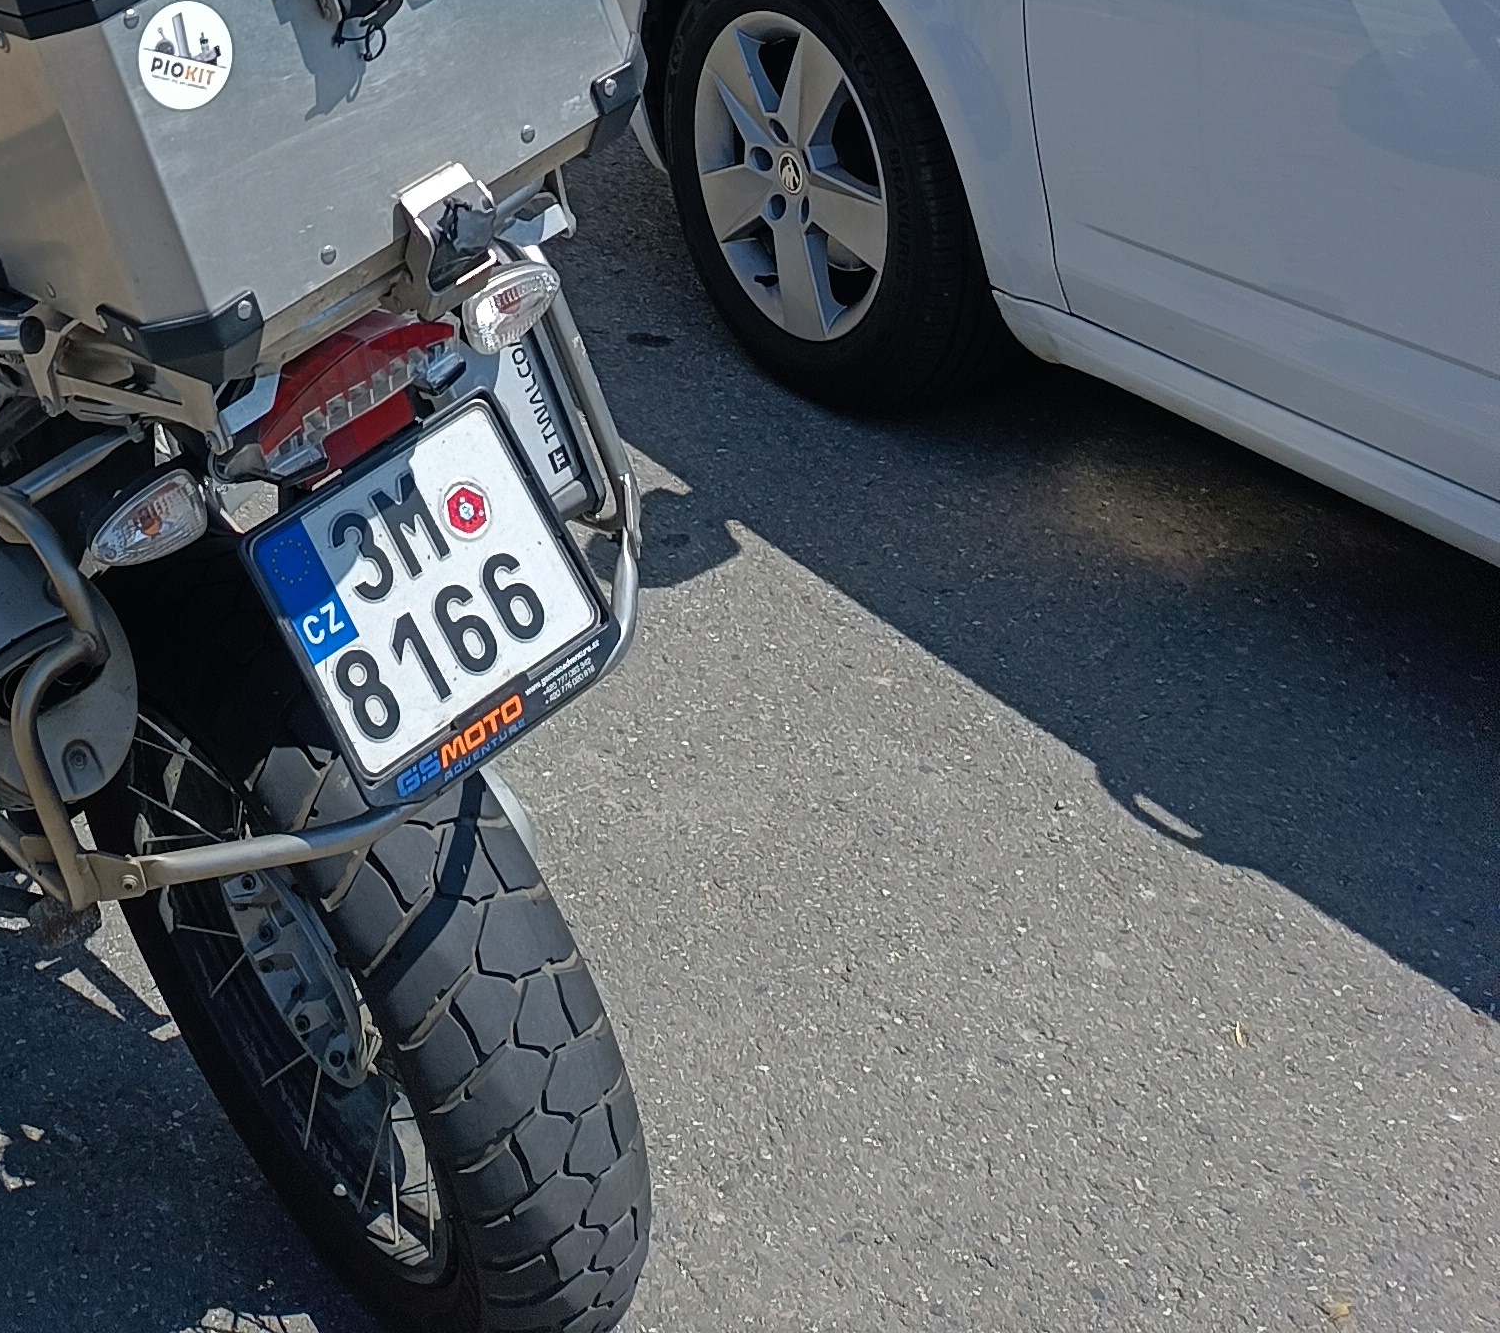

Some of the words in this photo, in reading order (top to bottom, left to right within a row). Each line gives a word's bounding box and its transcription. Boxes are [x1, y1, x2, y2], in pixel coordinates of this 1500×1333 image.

[151, 57, 215, 85] PIOKIT
[330, 473, 451, 602] 3M
[302, 601, 344, 645] CZ
[335, 552, 545, 742] 8166
[444, 718, 527, 782] ADVENTURE
